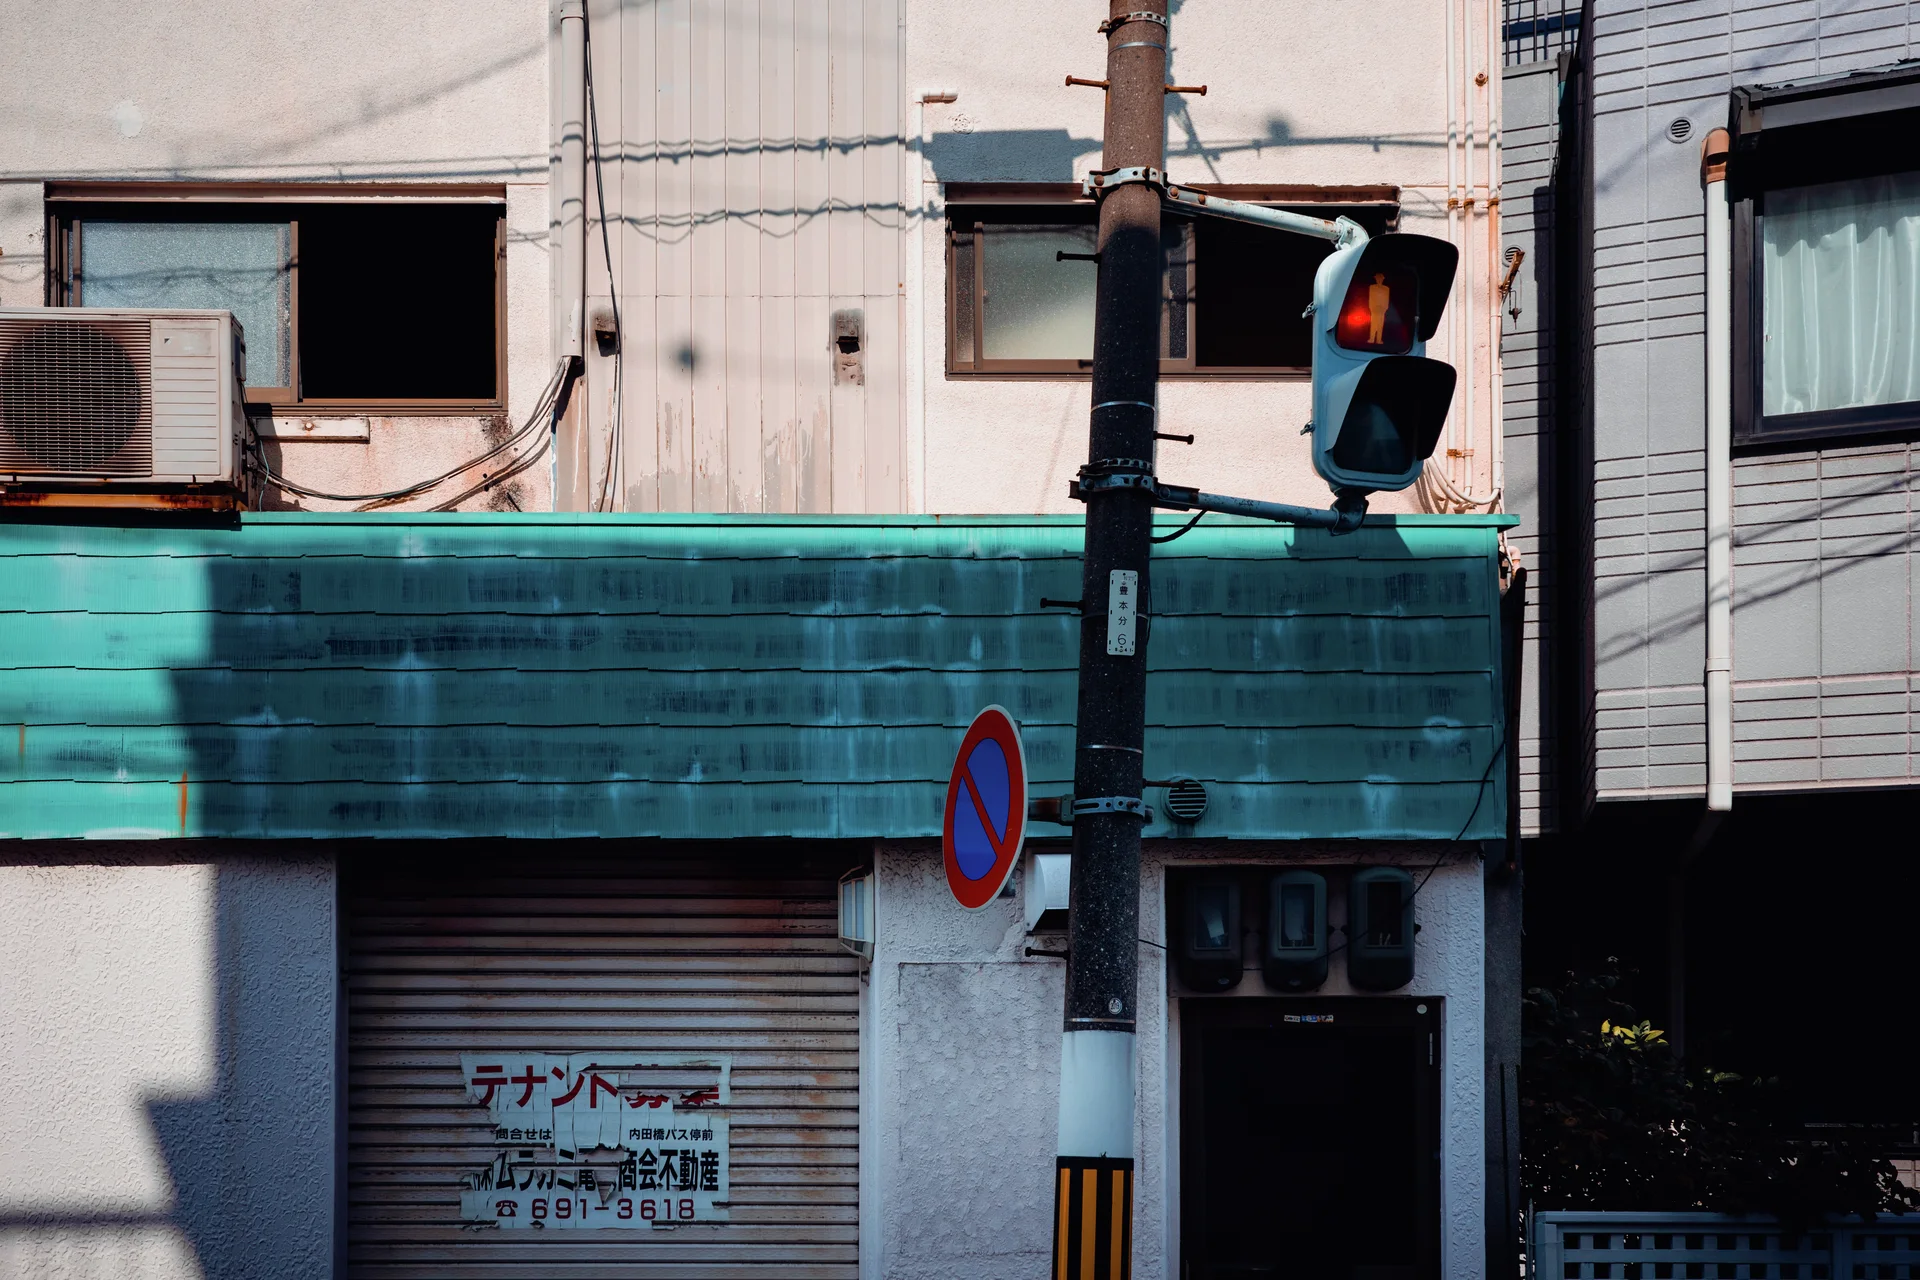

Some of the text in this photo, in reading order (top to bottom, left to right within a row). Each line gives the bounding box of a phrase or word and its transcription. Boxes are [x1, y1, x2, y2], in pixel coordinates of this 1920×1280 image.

[471, 1062, 719, 1108] テナント
[490, 1128, 552, 1140] 問合せは
[629, 1128, 714, 1141] 内田橋バス停前
[531, 1198, 696, 1220] 691-3618
